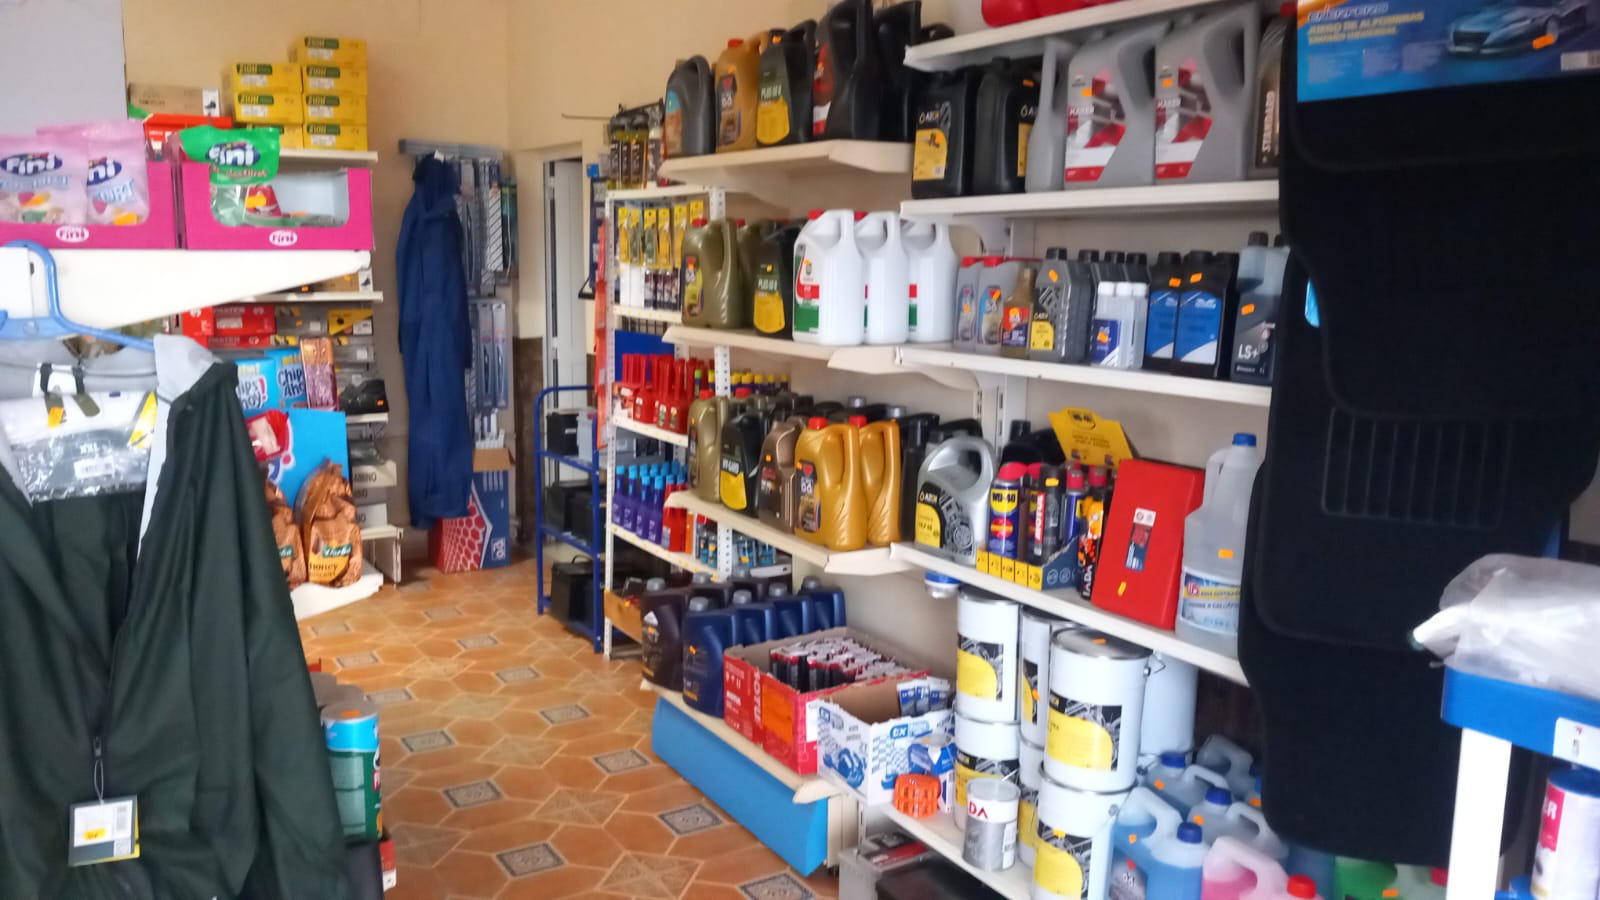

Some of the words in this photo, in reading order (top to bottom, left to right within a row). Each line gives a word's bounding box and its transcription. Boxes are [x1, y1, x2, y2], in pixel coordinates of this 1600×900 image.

[88, 158, 116, 182] ni
[992, 492, 1016, 503] WD-40
[968, 801, 988, 819] DA
